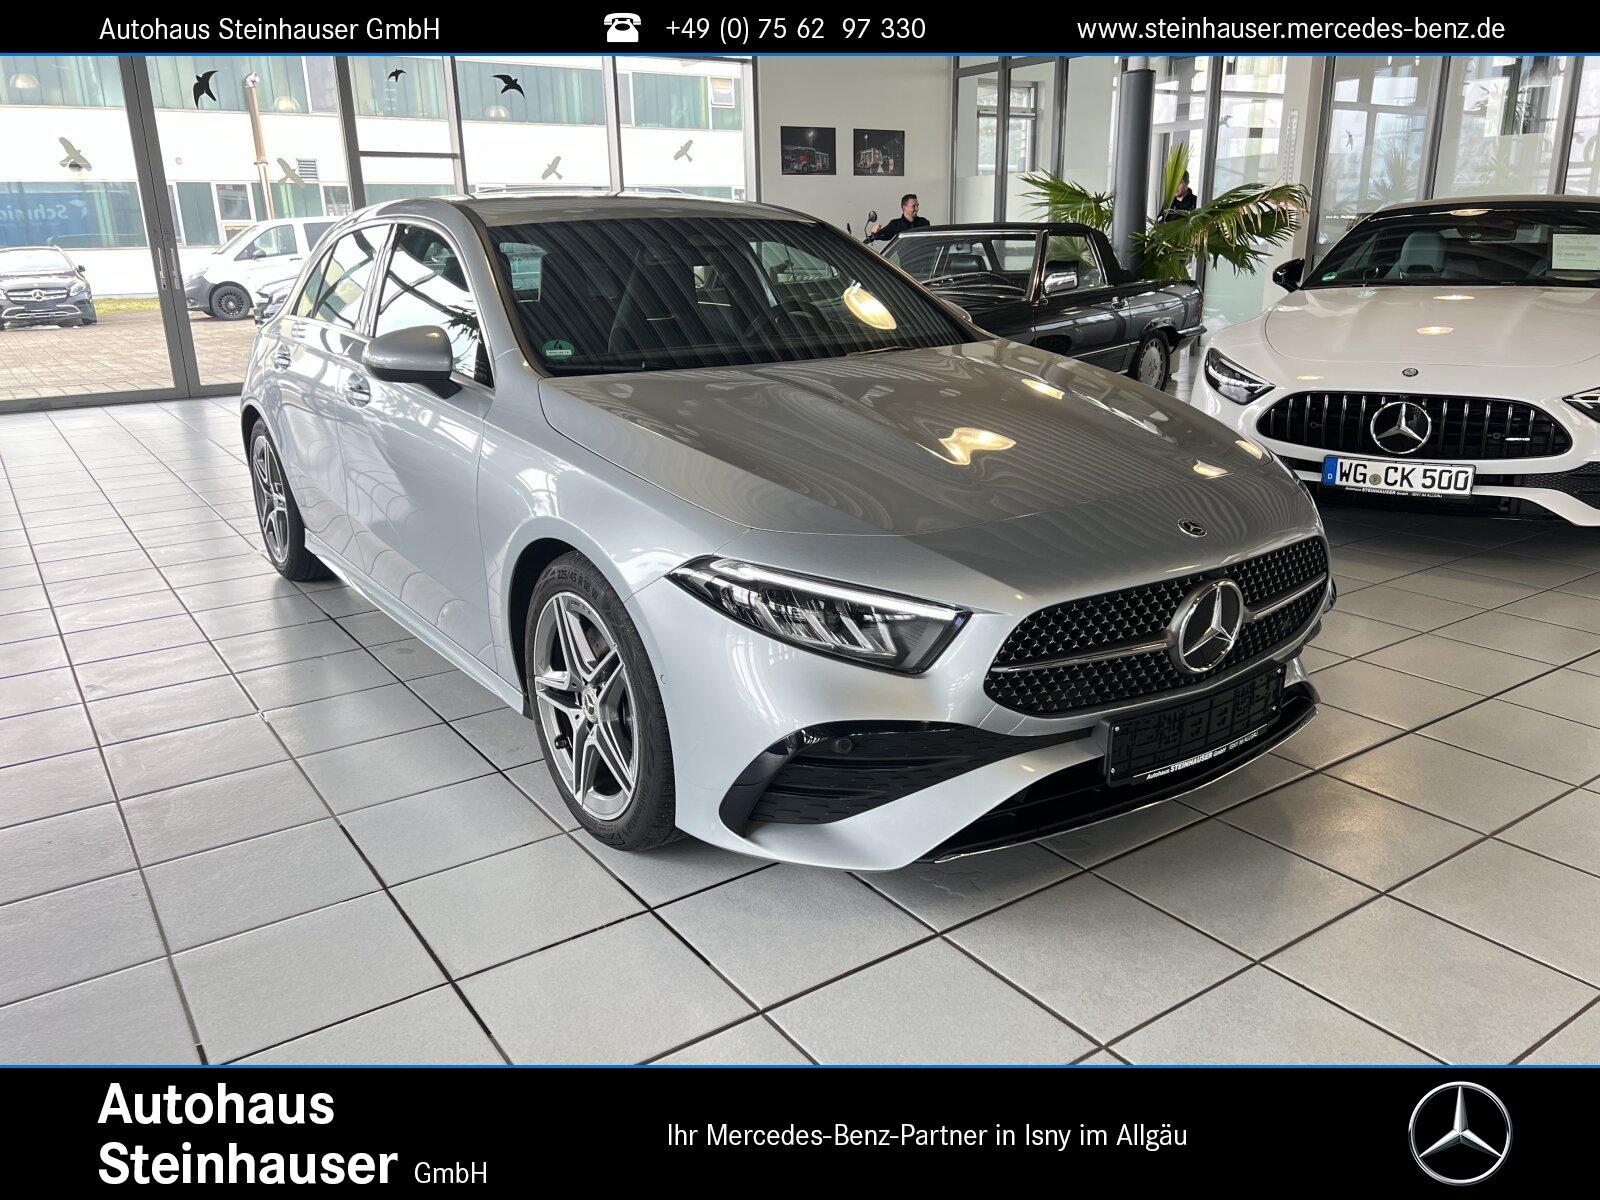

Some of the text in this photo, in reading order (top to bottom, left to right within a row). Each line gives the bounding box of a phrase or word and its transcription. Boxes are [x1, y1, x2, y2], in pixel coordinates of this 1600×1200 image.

[1339, 462, 1469, 491] WG CK 500
[1146, 769, 1170, 780] Autohaus
[1170, 753, 1213, 772] STEINHAUSER
